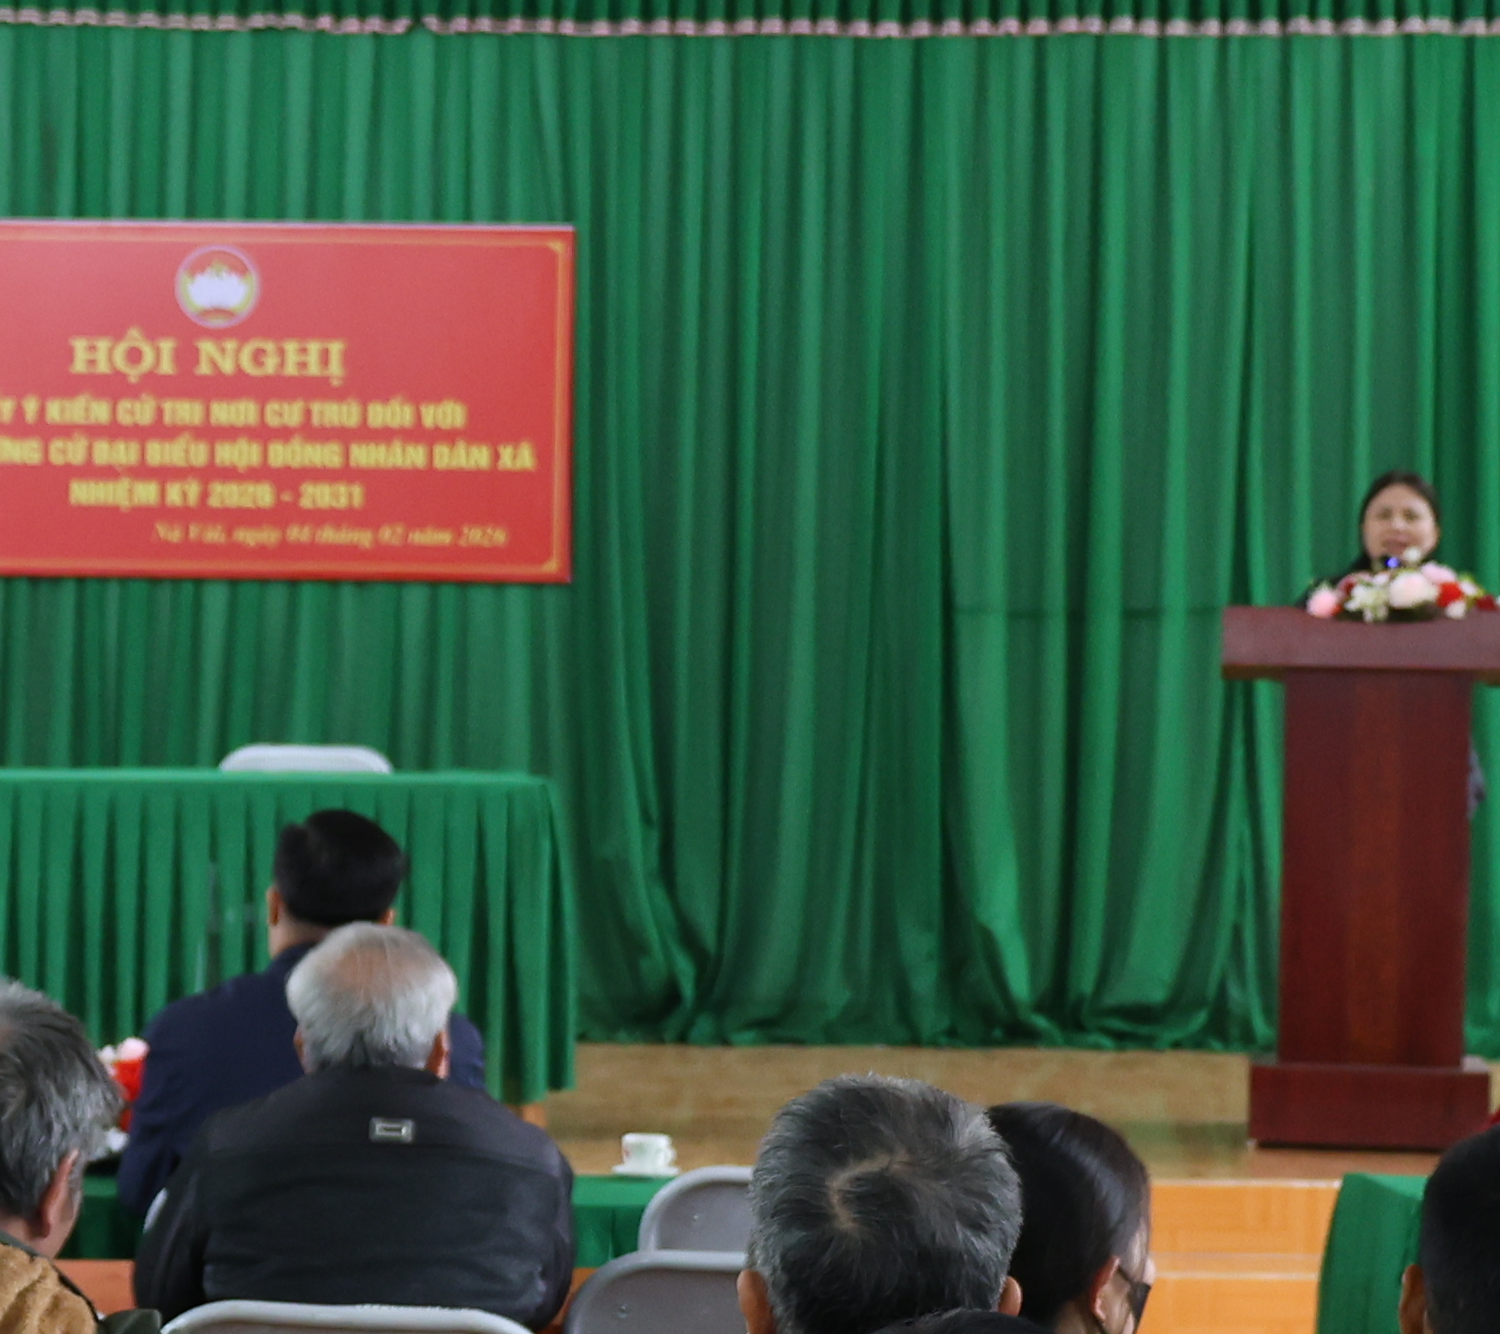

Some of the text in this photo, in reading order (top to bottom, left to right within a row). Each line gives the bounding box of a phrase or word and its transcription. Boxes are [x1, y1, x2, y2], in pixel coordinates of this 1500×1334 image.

[69, 326, 347, 387] HỘI NGHỊ
[298, 479, 366, 510] 2031
